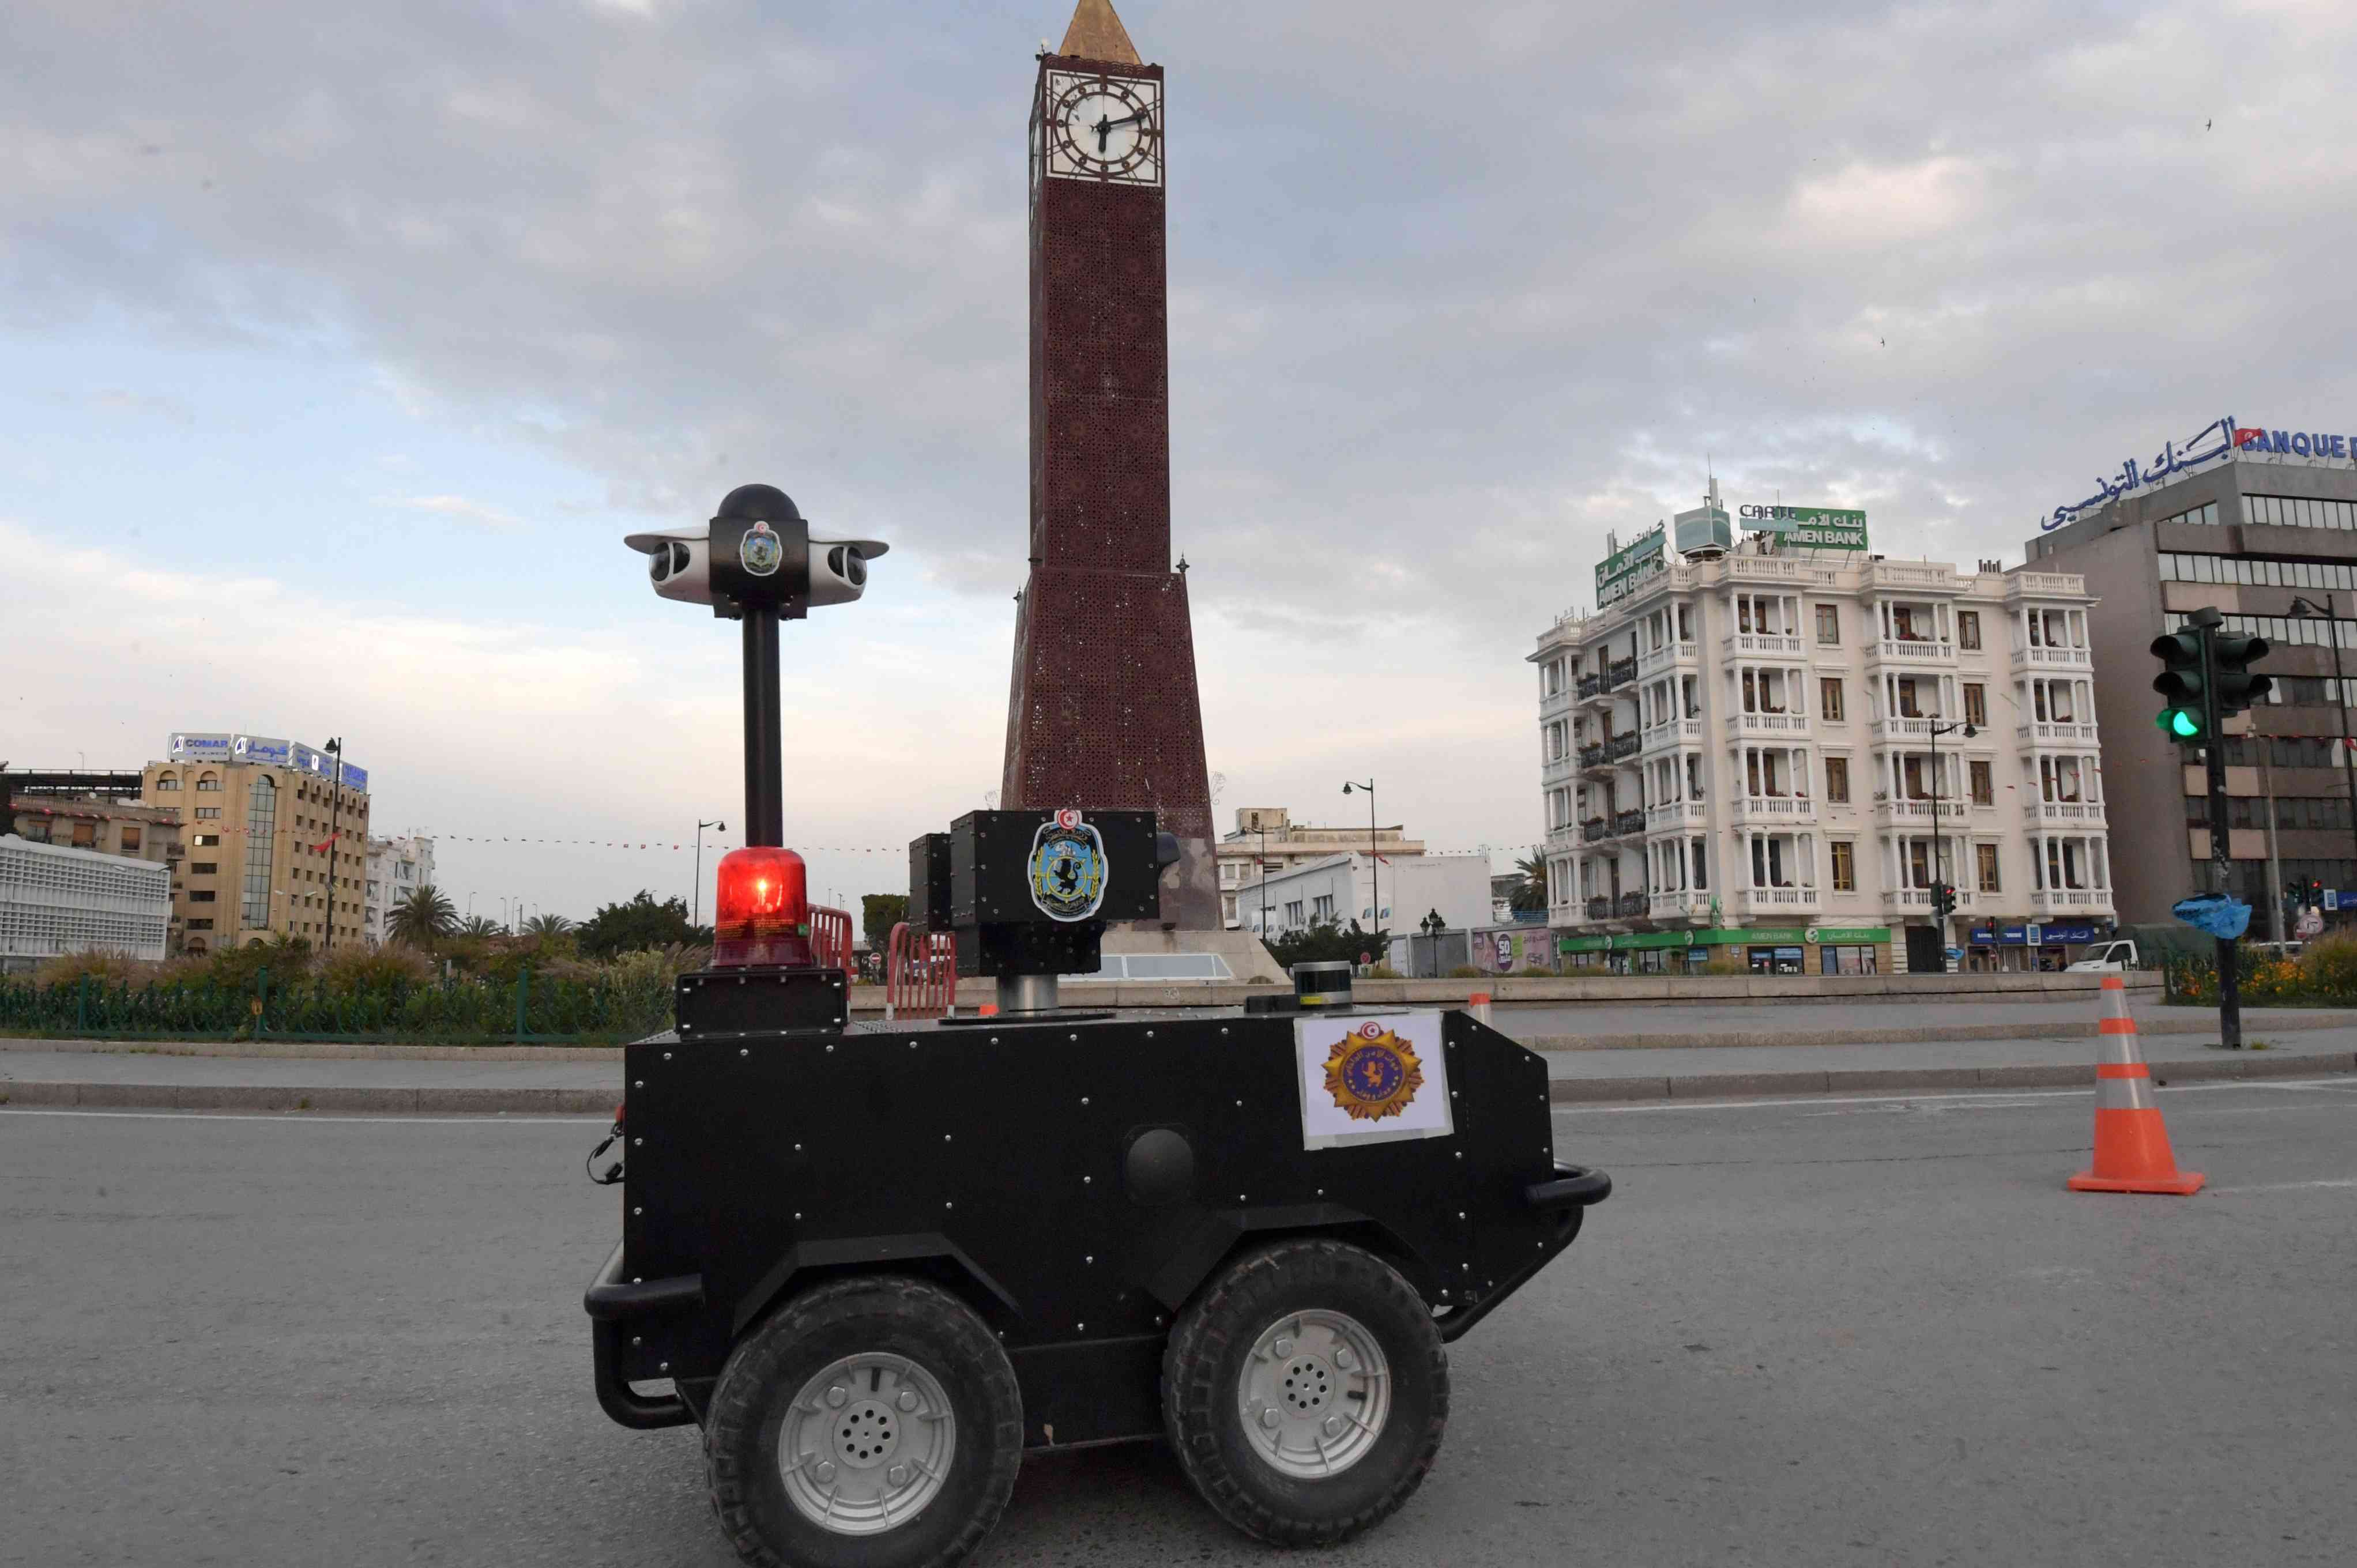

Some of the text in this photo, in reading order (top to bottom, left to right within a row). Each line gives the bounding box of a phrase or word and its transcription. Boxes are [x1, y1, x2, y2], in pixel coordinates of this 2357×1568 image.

[2041, 416, 2236, 530] البنك التونسي
[1739, 504, 1796, 519] CARTE
[1833, 514, 1863, 532] بنك
[1784, 530, 1864, 545] AMEN BANK
[1599, 576, 1628, 607] AMEN
[185, 739, 228, 748] COMAR
